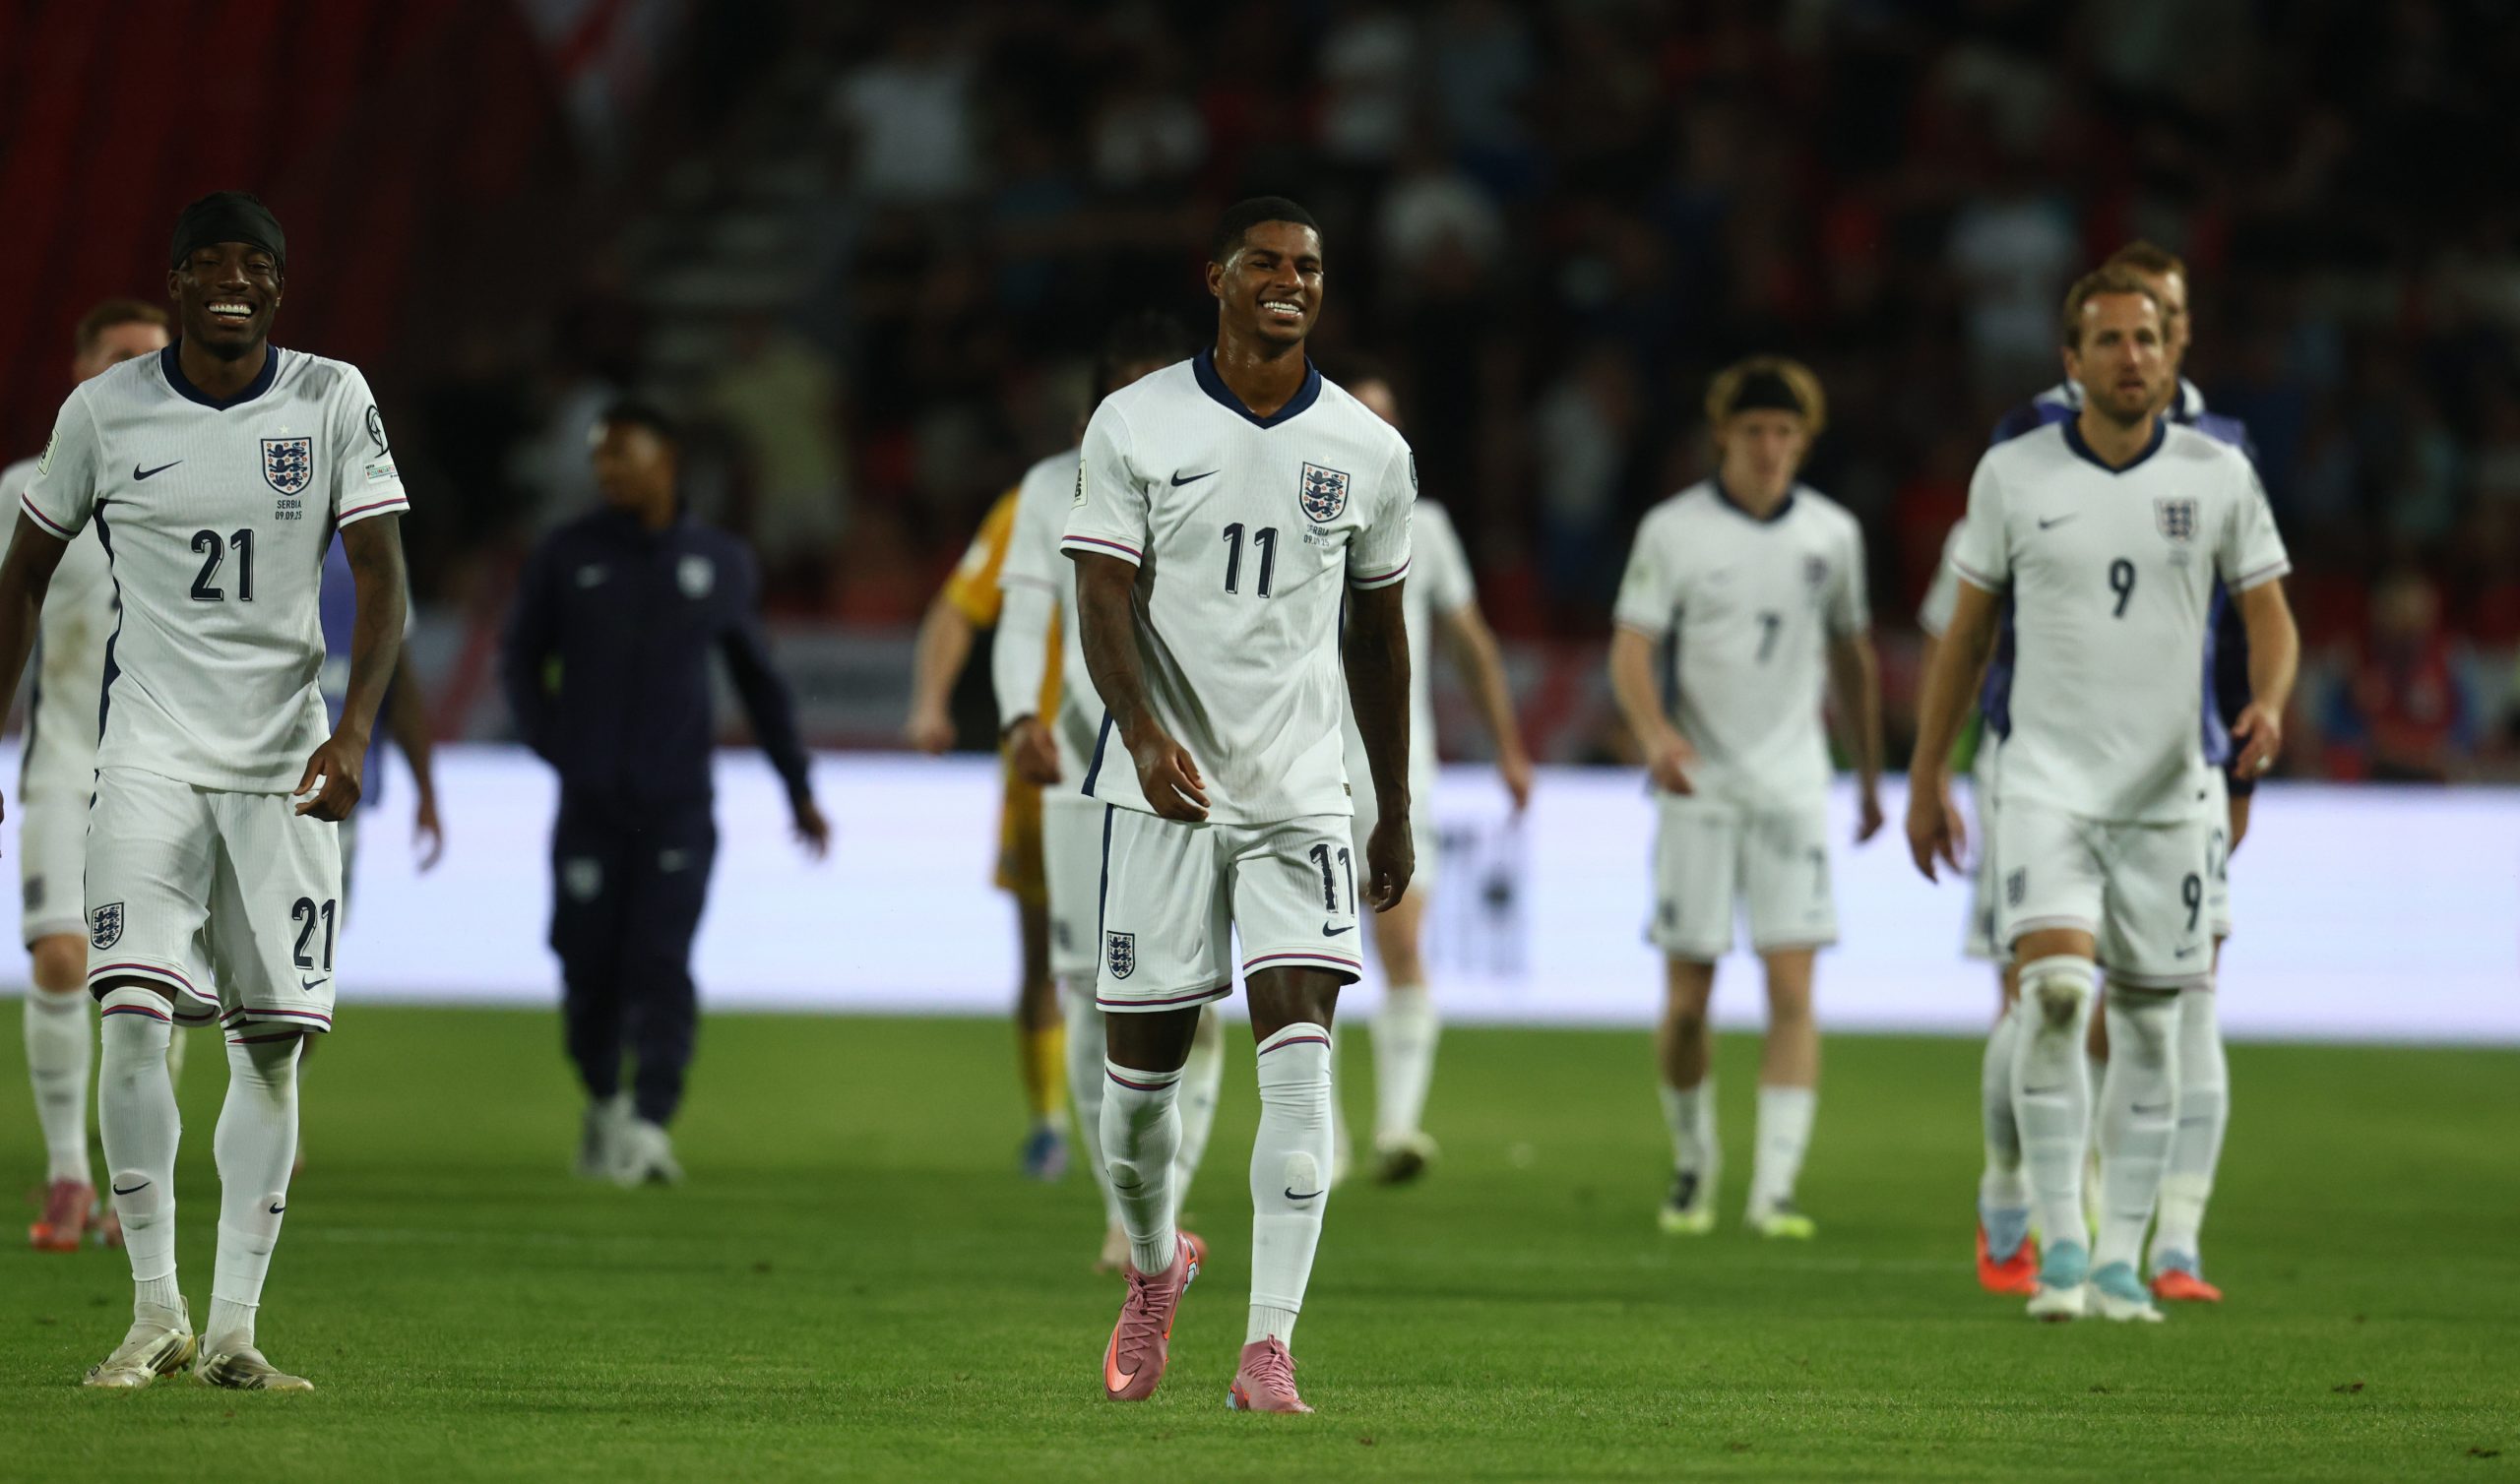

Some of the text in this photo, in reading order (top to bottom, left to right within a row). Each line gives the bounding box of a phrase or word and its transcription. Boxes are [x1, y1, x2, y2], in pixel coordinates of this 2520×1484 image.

[276, 511, 302, 520] 09.09.25
[277, 500, 301, 509] SERBIA
[191, 528, 254, 601] 21
[1223, 523, 1278, 598] 11
[2109, 556, 2136, 620] 9
[1754, 608, 1782, 666] 7
[1309, 844, 1354, 918] 11
[2181, 872, 2201, 933] 9
[292, 897, 336, 971] 21
